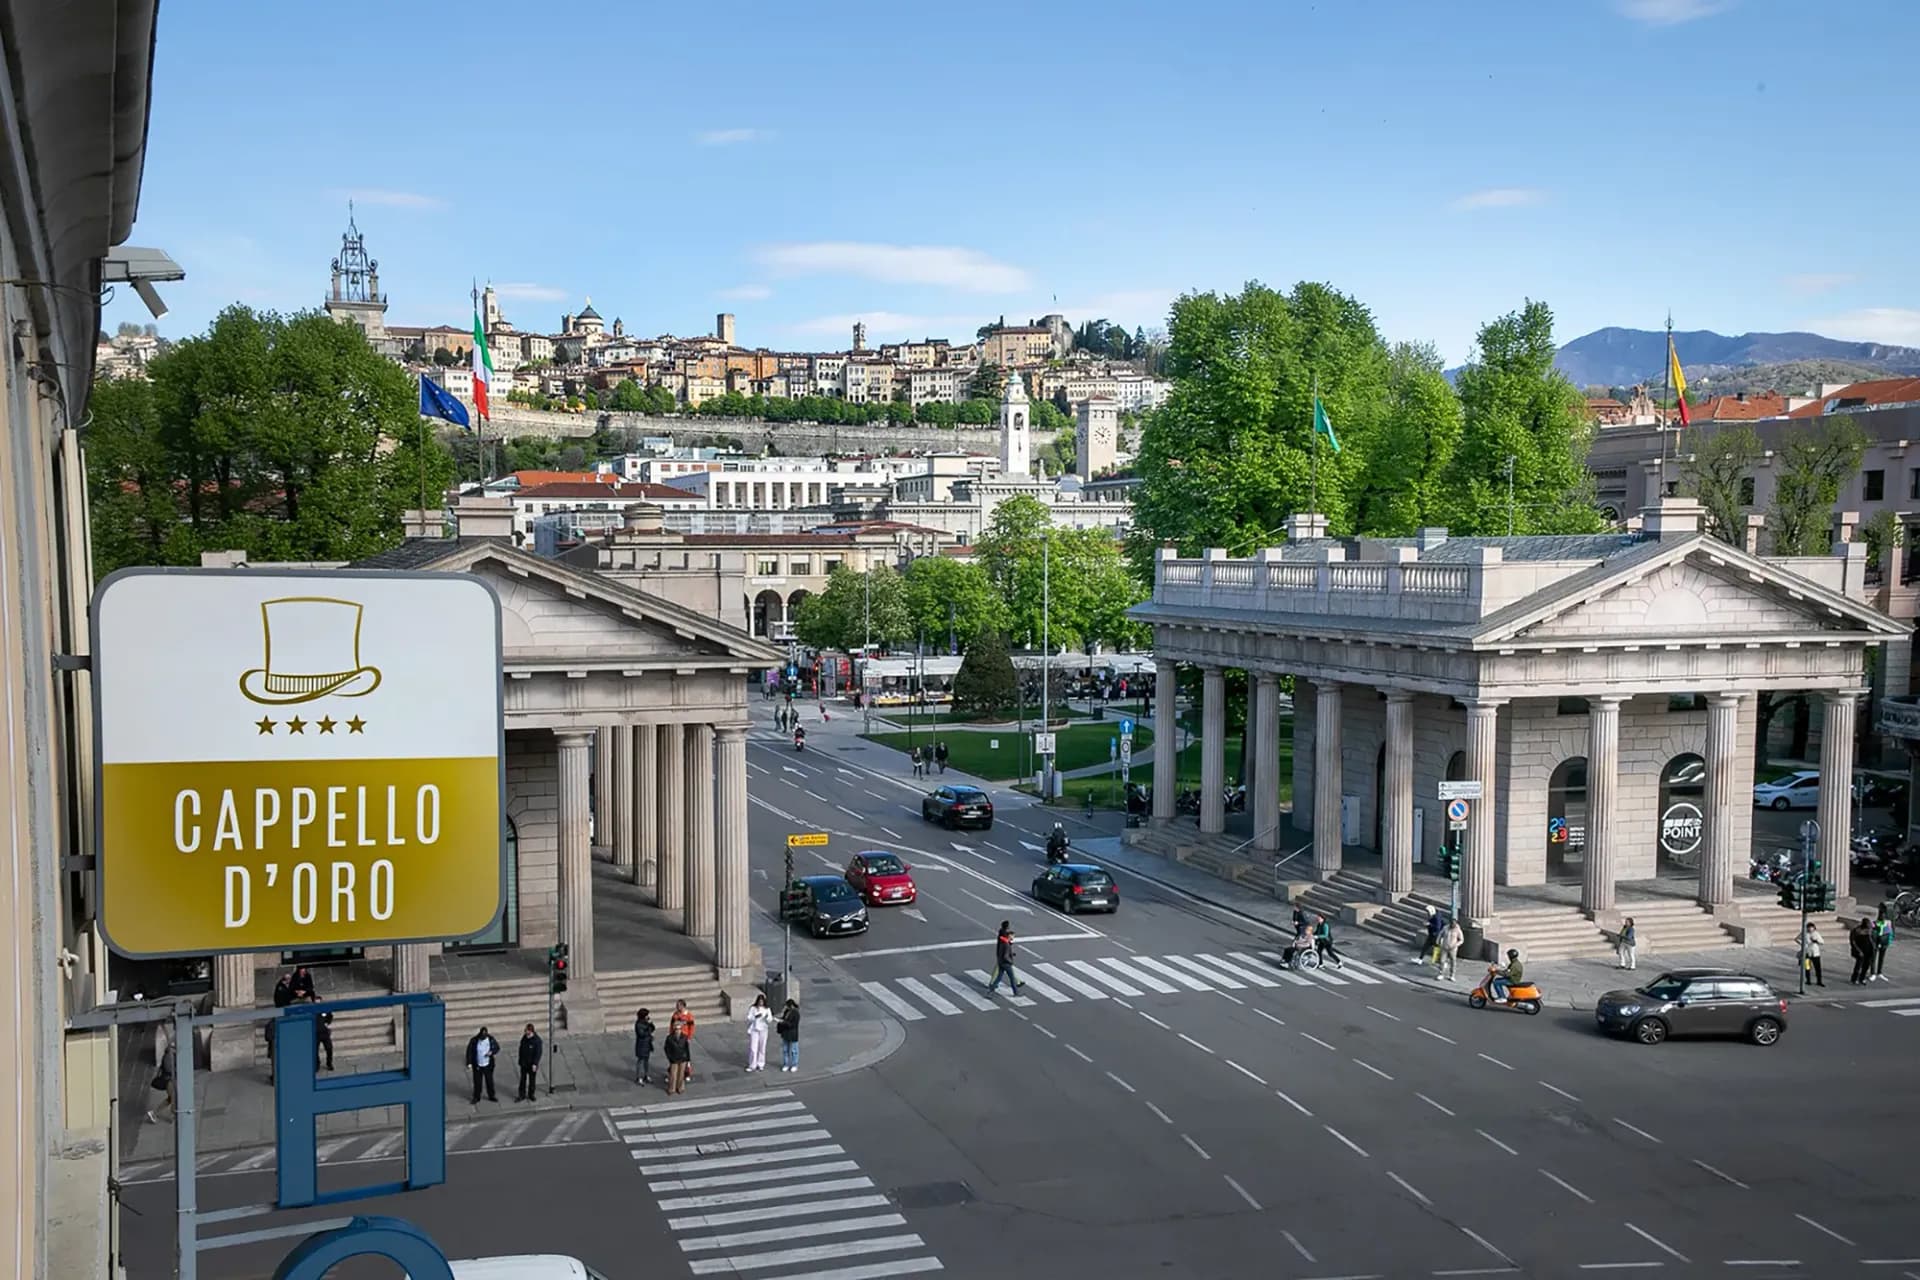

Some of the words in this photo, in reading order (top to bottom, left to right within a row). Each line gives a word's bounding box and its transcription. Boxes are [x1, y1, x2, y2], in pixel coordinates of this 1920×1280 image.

[174, 784, 441, 854] CAPPELLO
[1663, 826, 1702, 839] POINT
[224, 858, 395, 928] D'ORO
